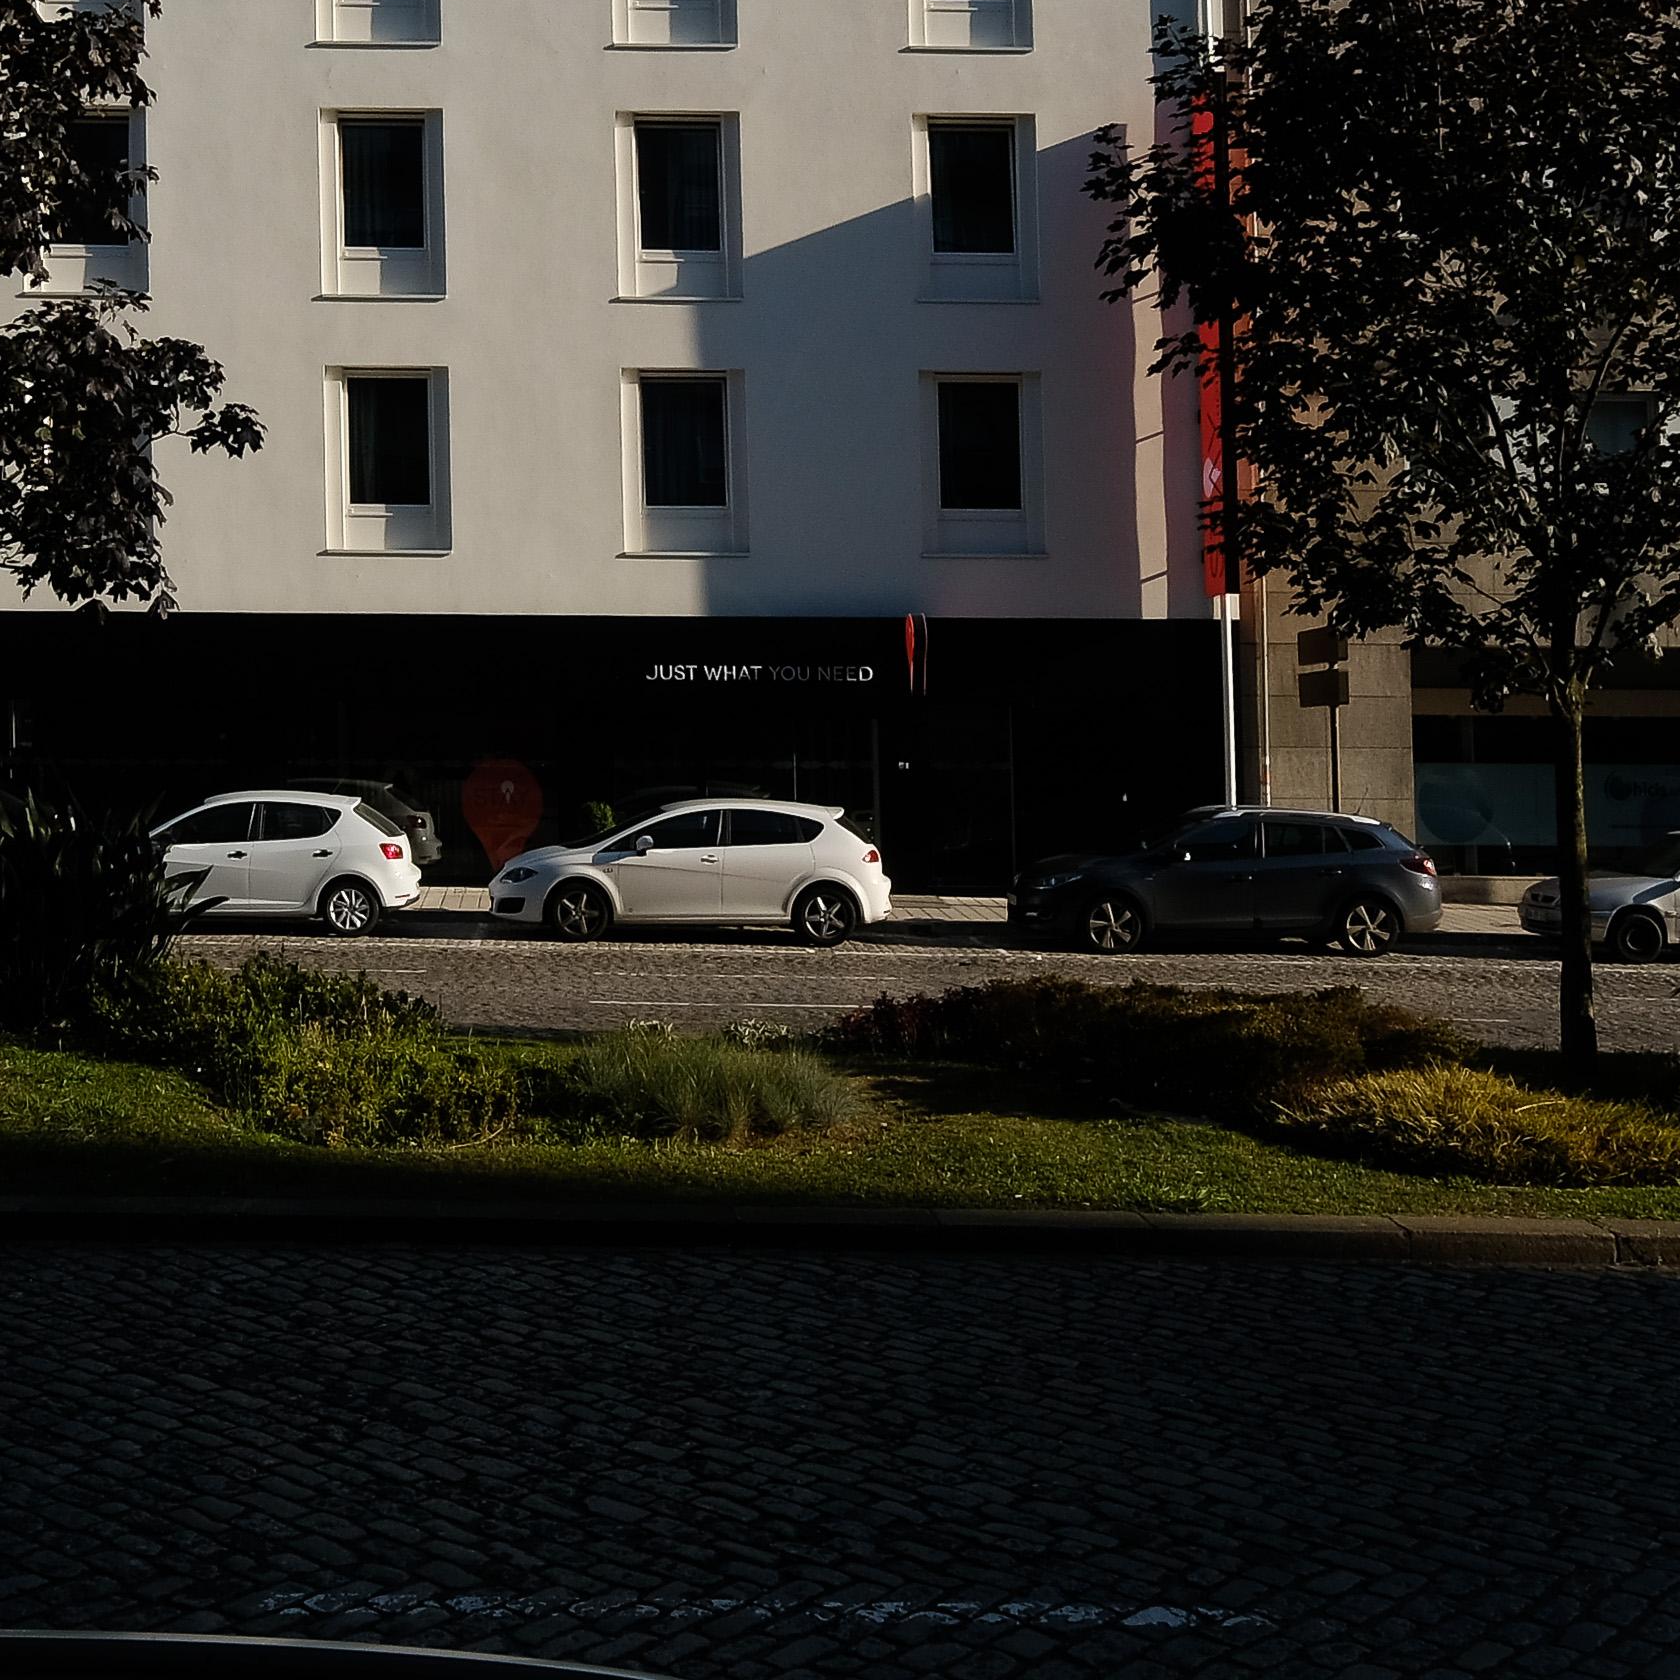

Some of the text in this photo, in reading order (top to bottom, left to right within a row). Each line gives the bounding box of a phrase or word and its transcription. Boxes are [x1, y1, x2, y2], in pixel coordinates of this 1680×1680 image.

[645, 664, 874, 682] JUST WHAT YOU NEED
